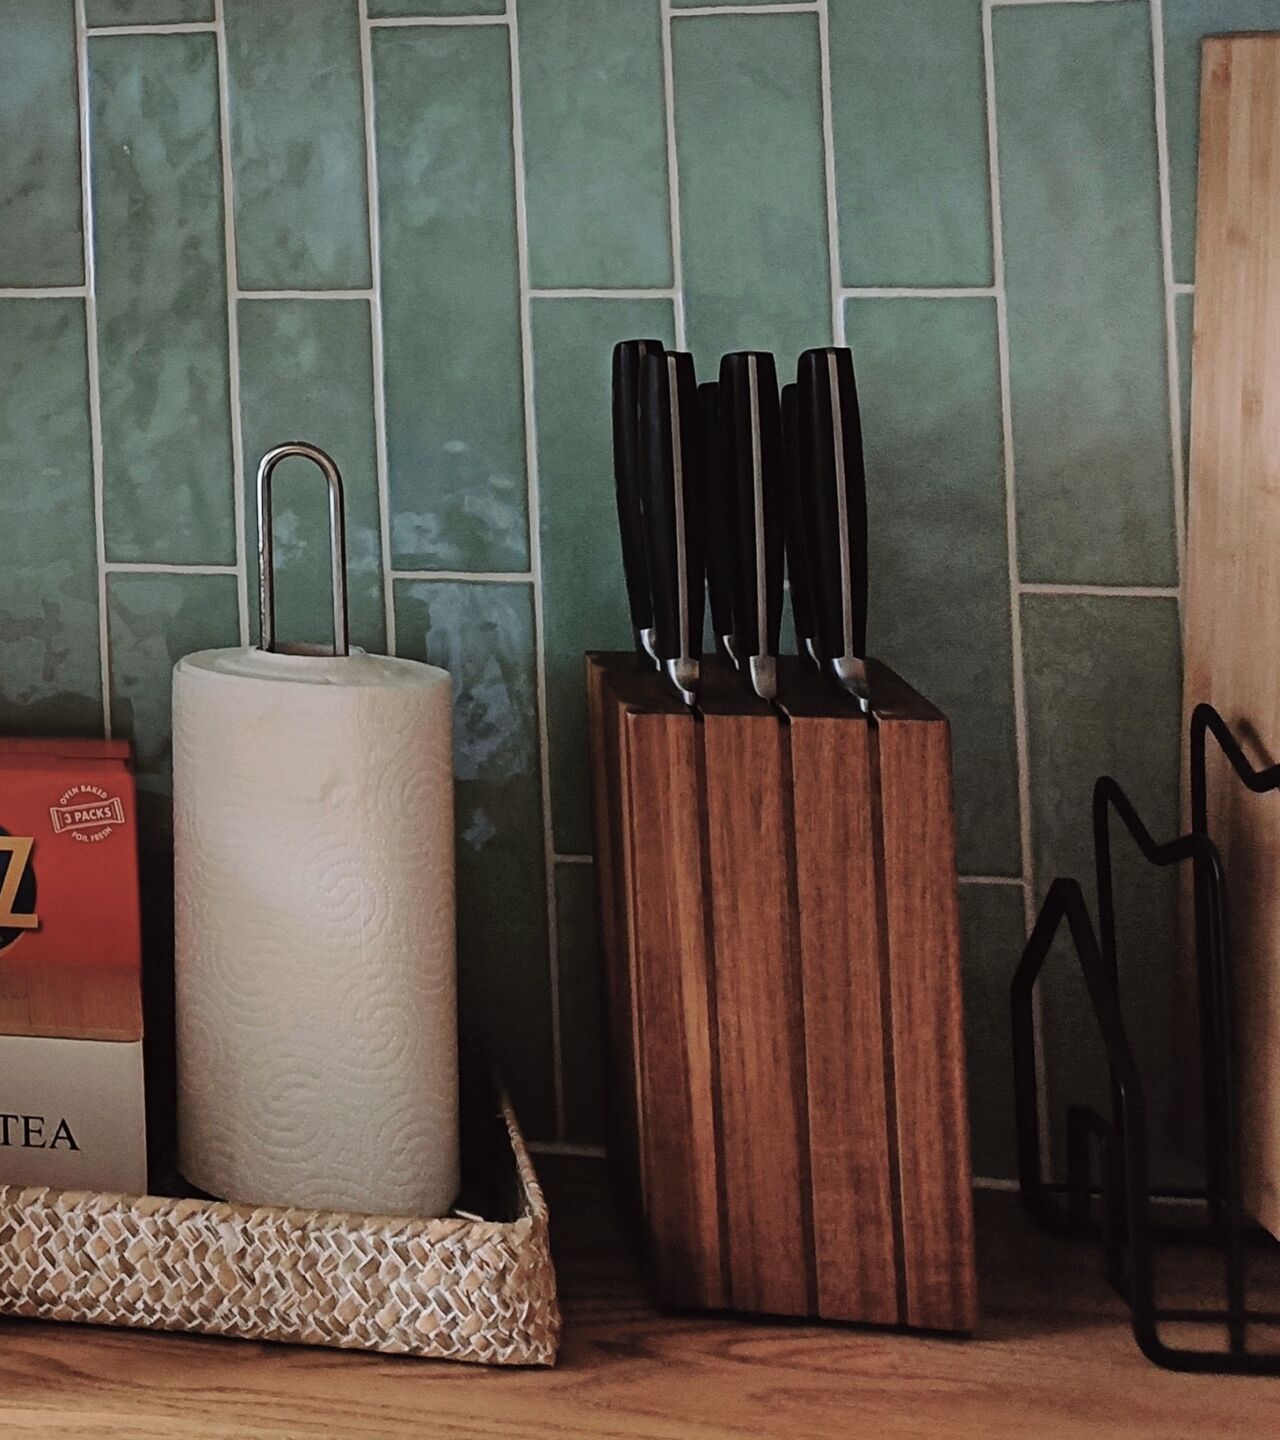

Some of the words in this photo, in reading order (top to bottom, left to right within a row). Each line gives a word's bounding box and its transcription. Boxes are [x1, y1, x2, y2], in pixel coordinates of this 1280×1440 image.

[60, 786, 79, 805] OVEN
[80, 785, 108, 799] BAKED
[64, 813, 72, 824] 3
[74, 807, 112, 822] PACKS
[90, 826, 113, 842] FRESH
